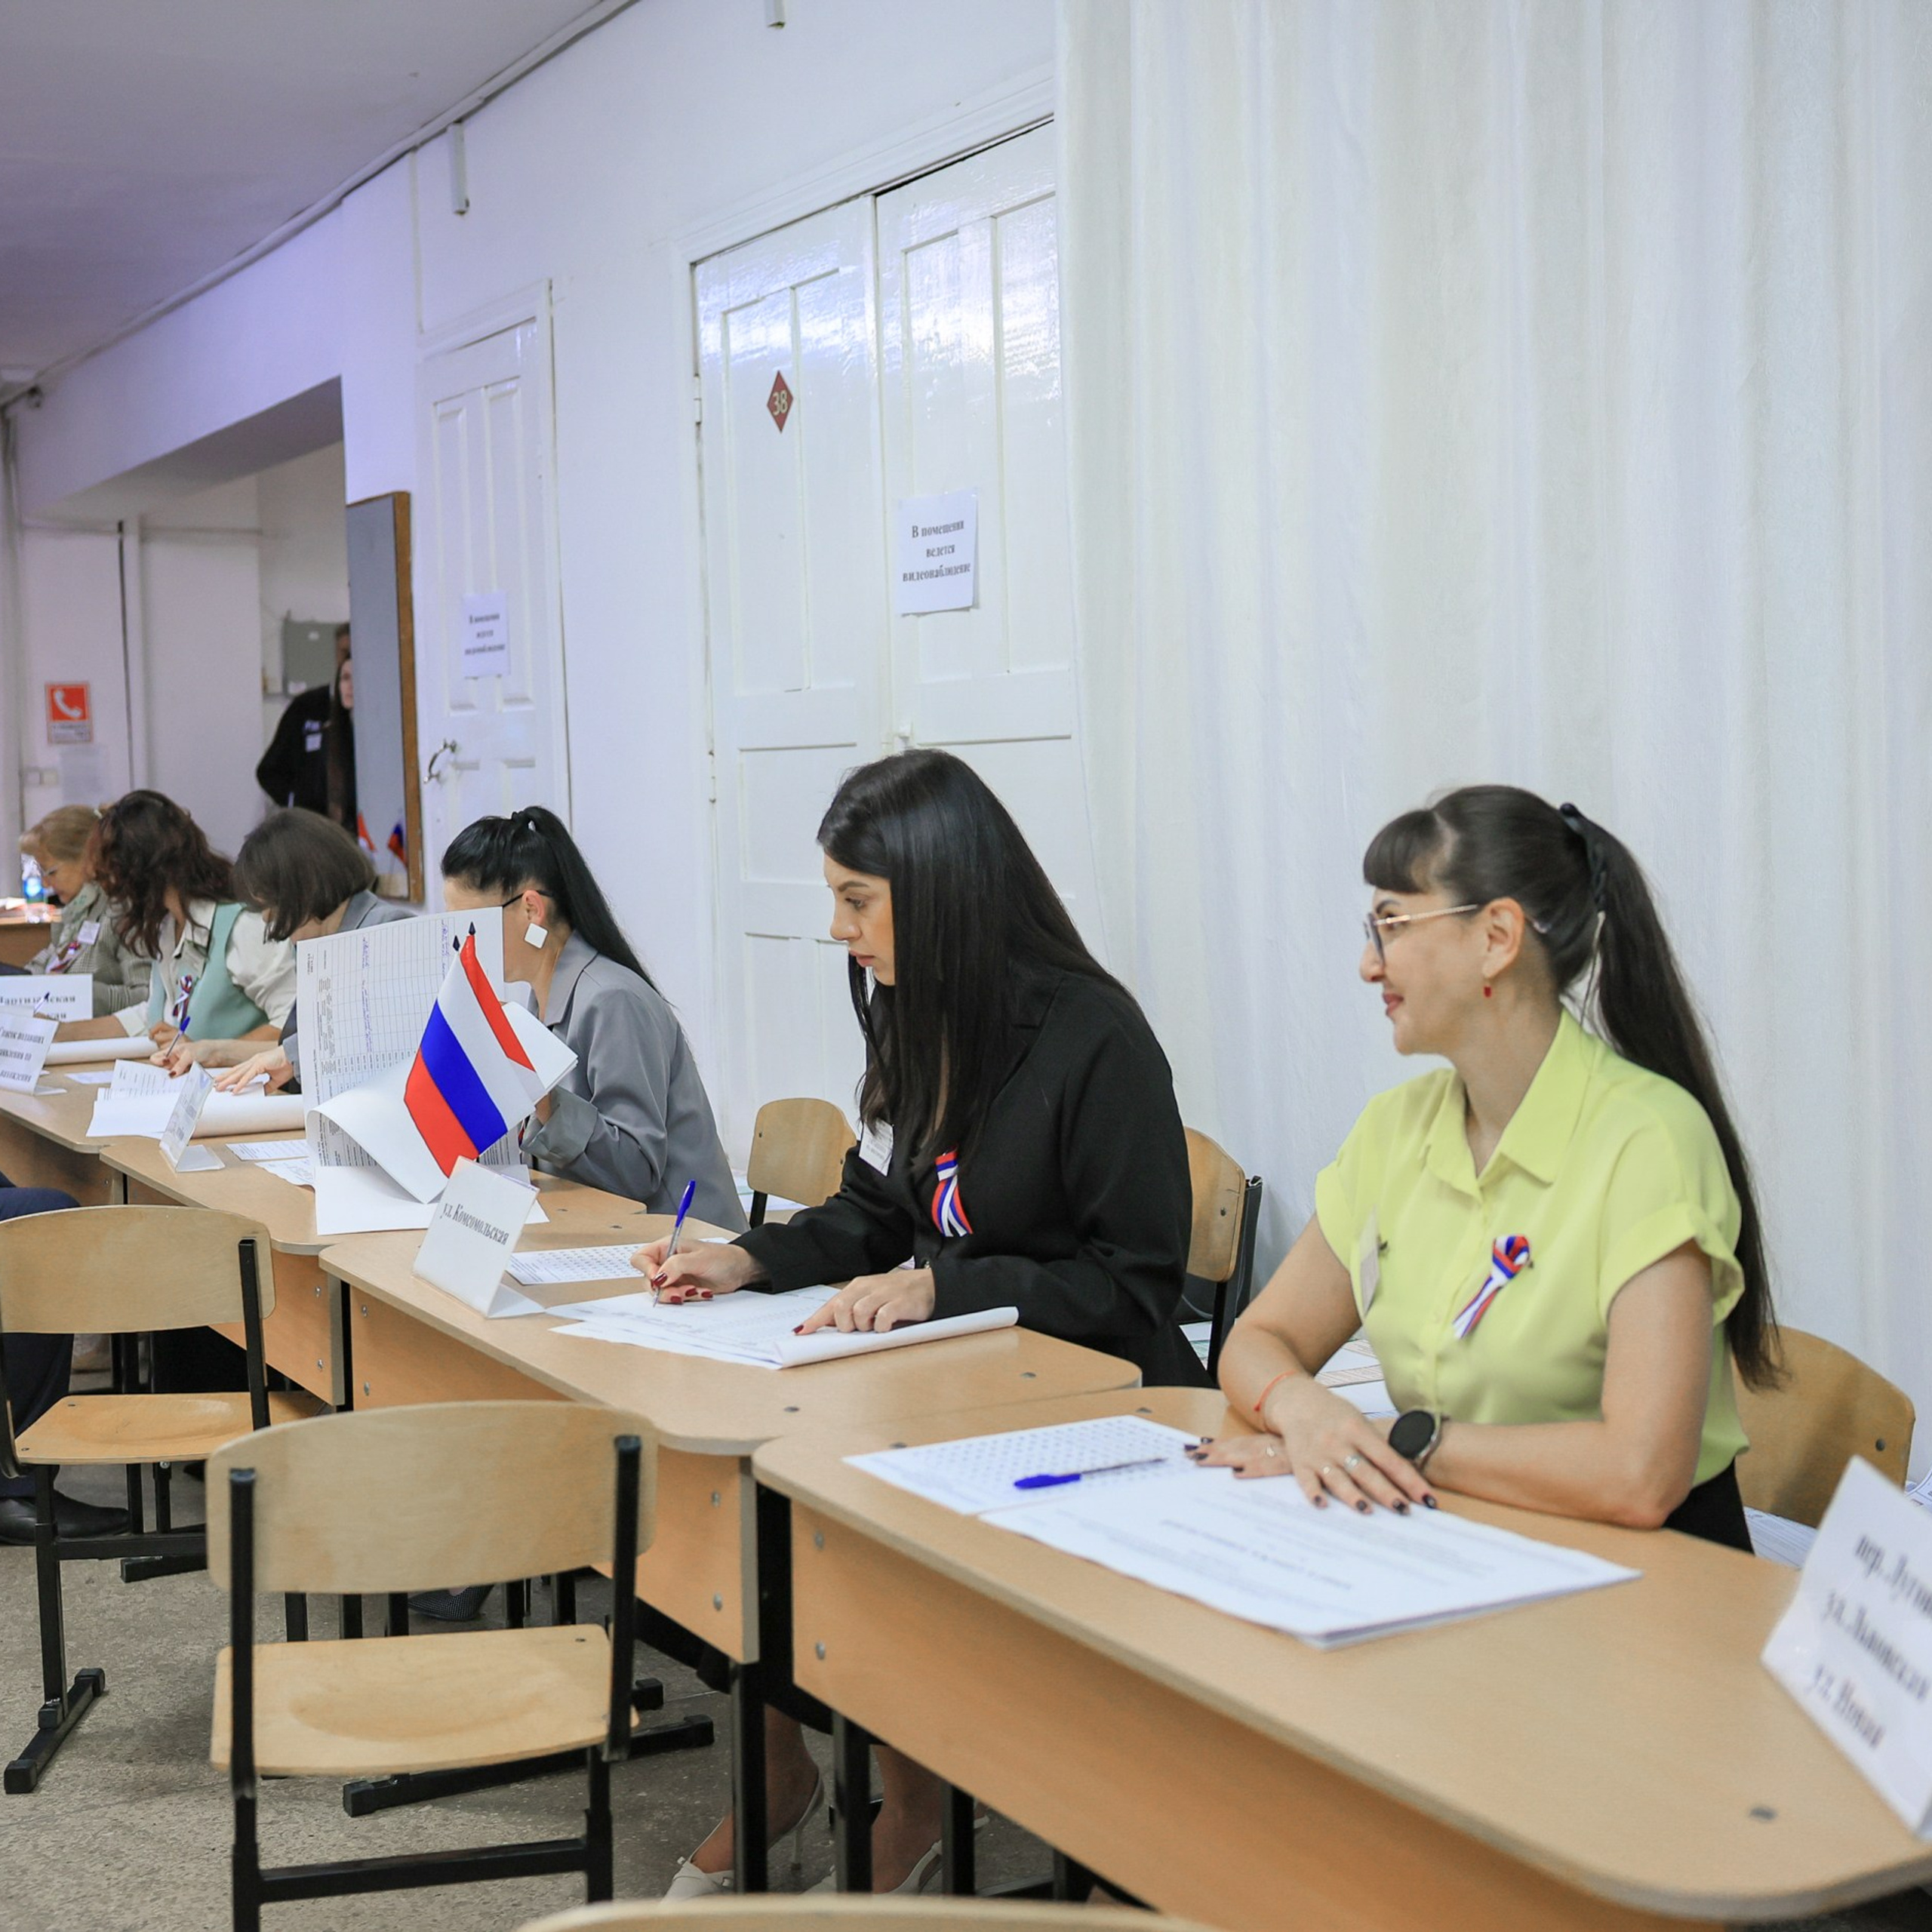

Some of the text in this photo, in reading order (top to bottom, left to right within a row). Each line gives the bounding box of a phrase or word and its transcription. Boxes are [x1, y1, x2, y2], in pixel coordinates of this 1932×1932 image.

[773, 389, 788, 416] 38
[912, 525, 919, 538] В
[440, 1203, 509, 1245] ул. Комсомольская
